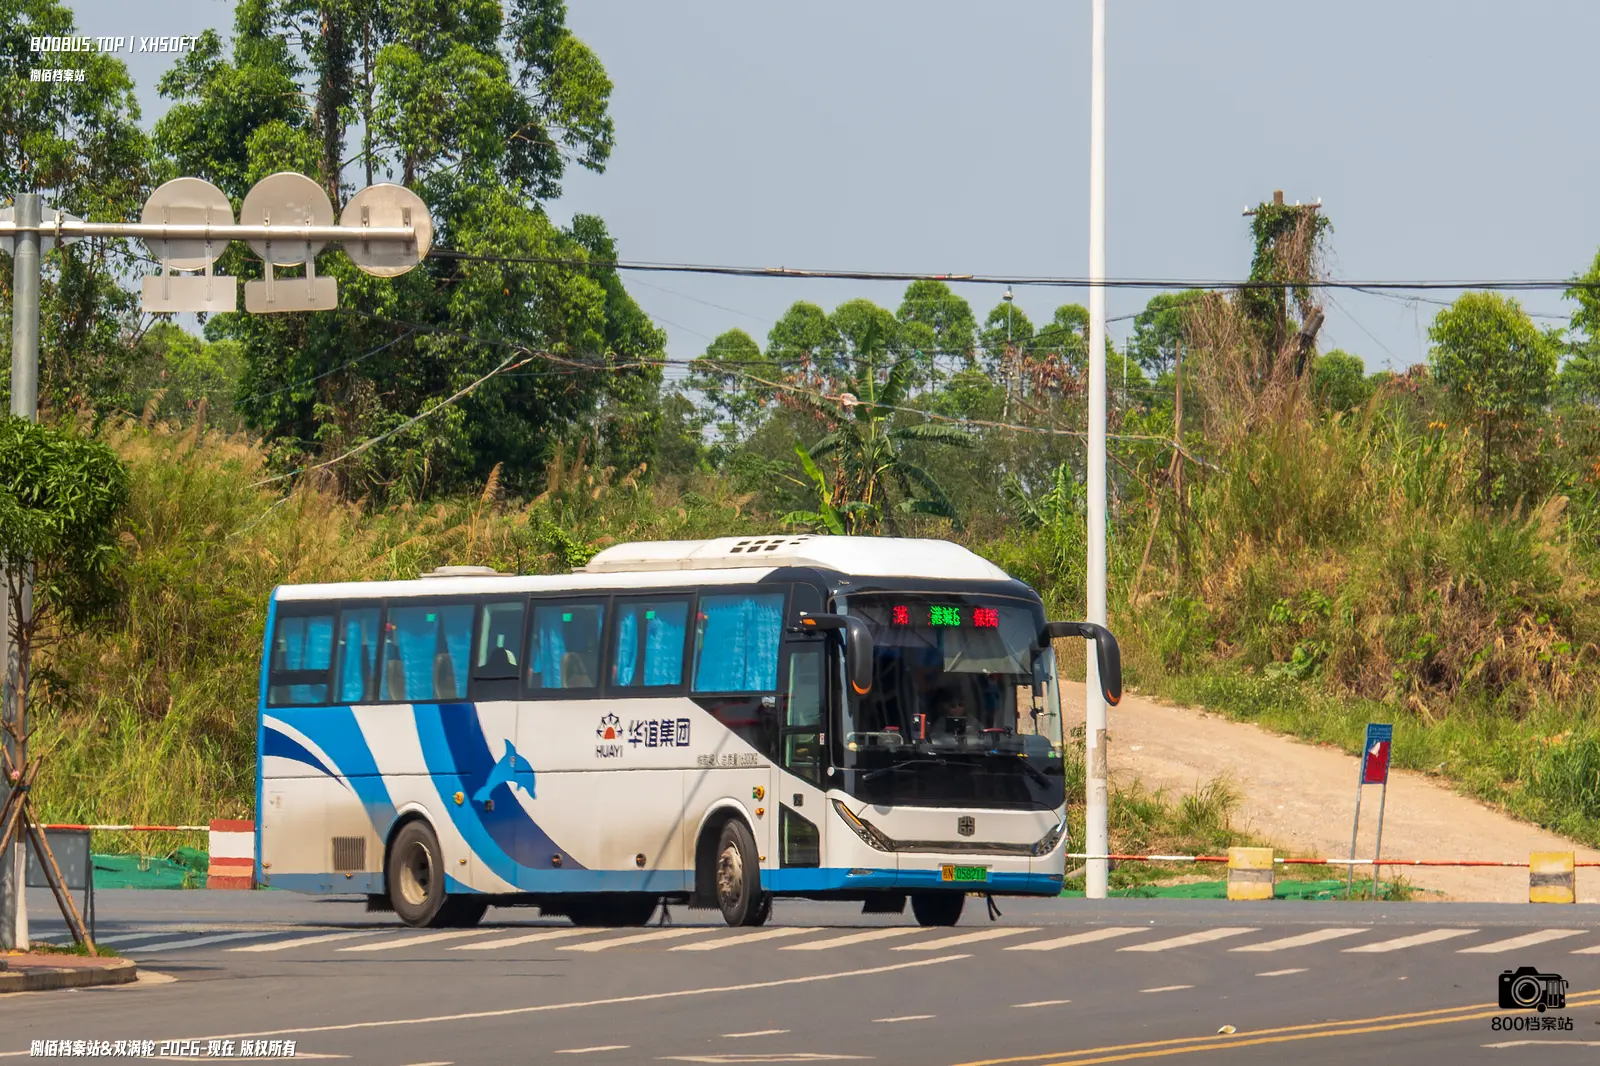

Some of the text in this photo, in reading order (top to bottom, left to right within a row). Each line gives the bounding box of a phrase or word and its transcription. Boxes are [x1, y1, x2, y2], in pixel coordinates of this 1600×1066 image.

[628, 717, 691, 749] 华谊集团
[595, 744, 624, 758] HUAYI
